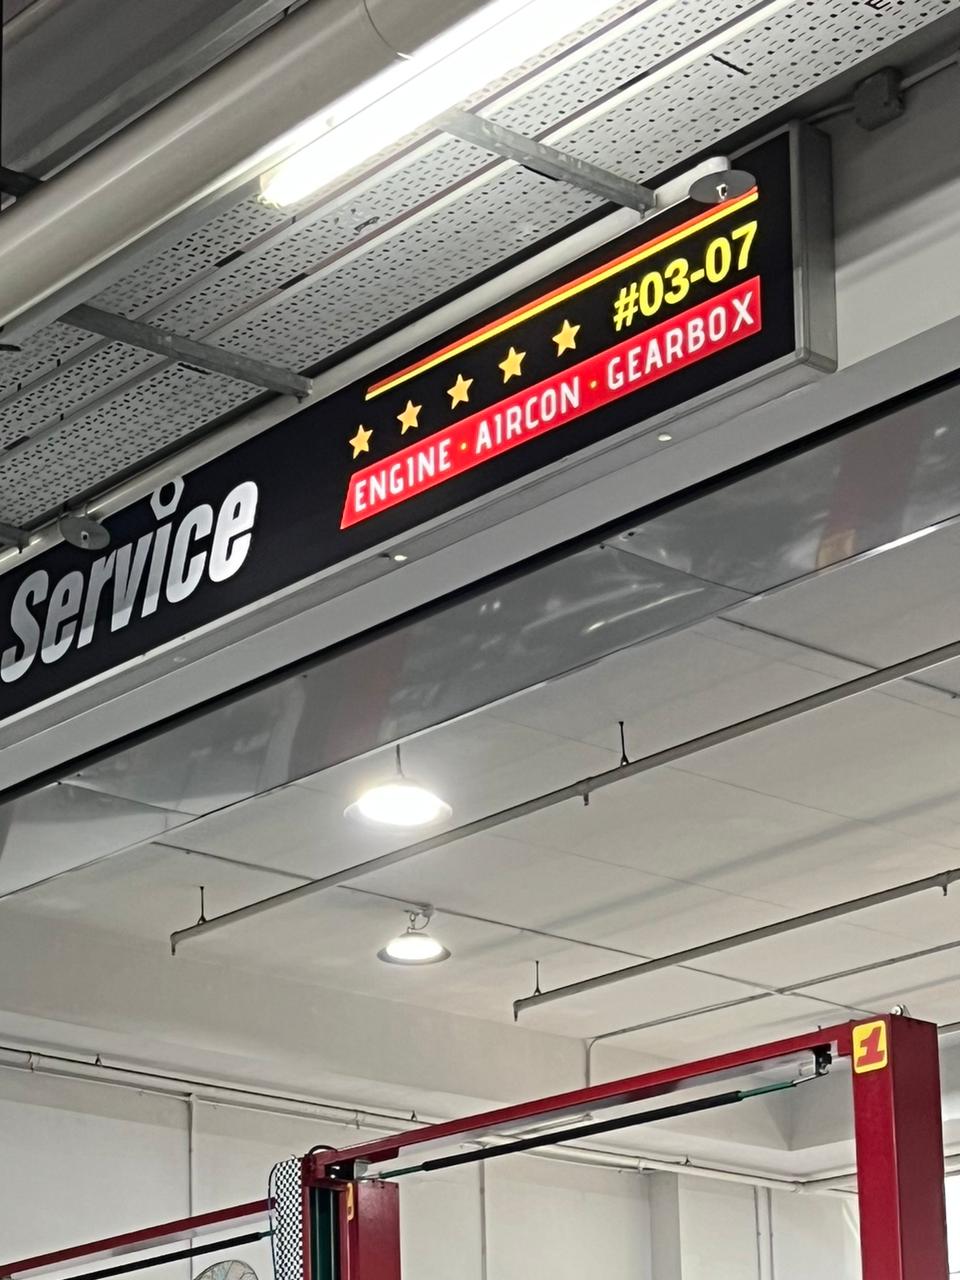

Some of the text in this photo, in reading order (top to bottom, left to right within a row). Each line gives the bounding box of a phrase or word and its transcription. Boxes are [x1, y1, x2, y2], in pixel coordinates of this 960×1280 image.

[613, 220, 758, 332] #03-07
[353, 290, 756, 513] ENGINE AIRCON GEARBOX
[0, 480, 259, 684] Service
[857, 1027, 885, 1067] 1
